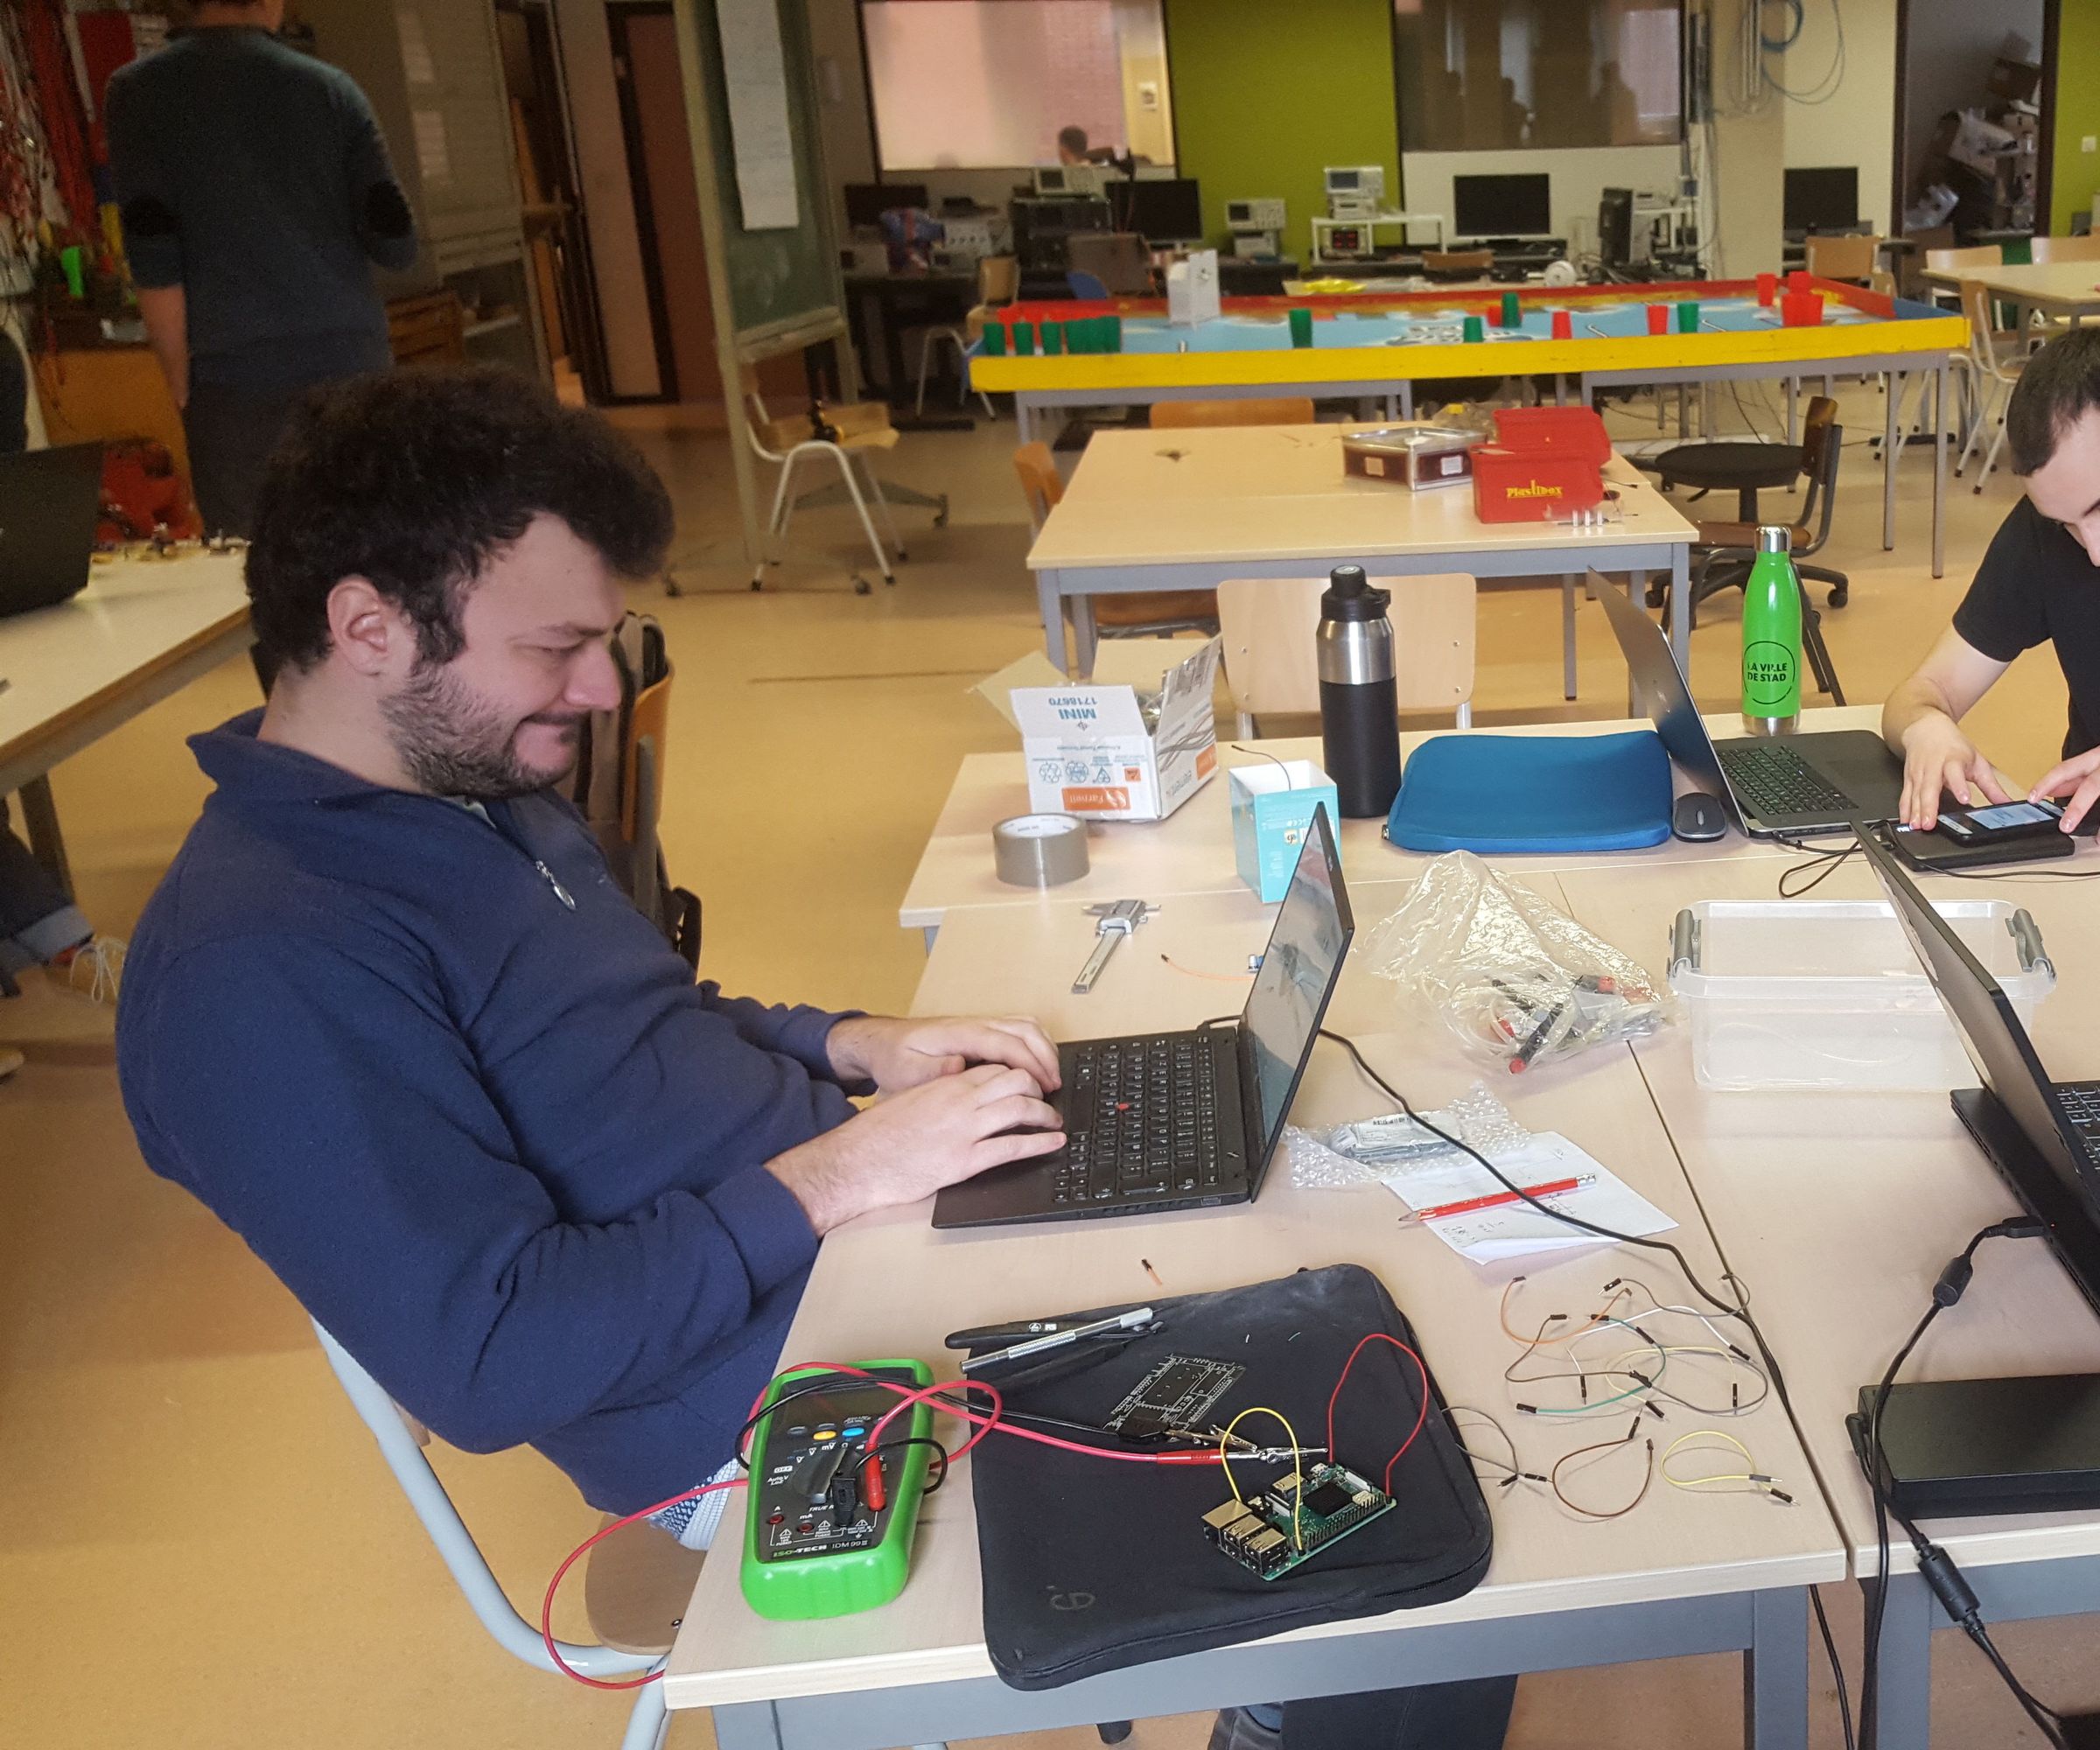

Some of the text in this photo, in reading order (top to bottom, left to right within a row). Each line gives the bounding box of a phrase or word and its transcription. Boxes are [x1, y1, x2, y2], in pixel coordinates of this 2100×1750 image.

[1506, 479, 1563, 500] Plastibox
[1746, 671, 1787, 682] DE STAD
[1058, 708, 1097, 720] MINI
[773, 1544, 828, 1558] ISO-TECH
